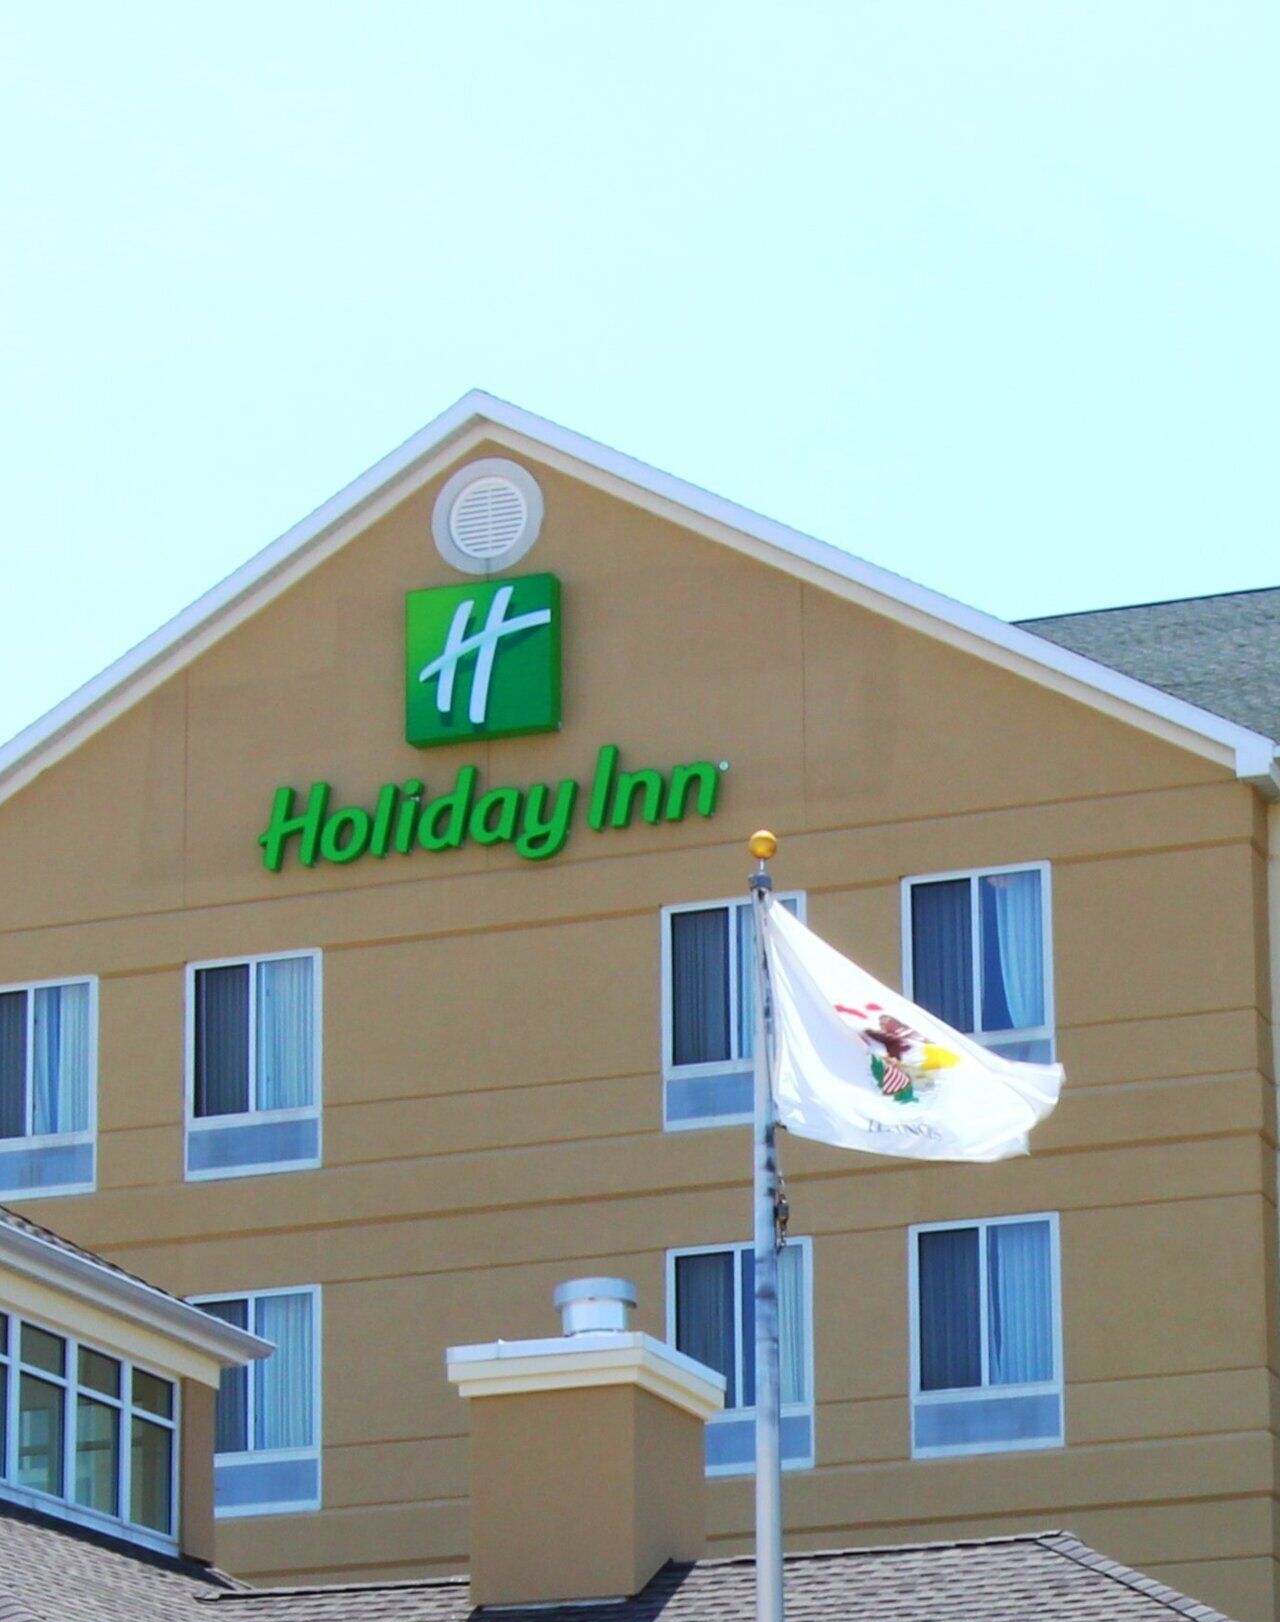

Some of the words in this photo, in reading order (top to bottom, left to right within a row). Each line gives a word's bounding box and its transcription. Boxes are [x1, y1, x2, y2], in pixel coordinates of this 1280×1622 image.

[420, 585, 552, 724] H
[258, 764, 579, 874] Holiday
[586, 743, 721, 833] Inn
